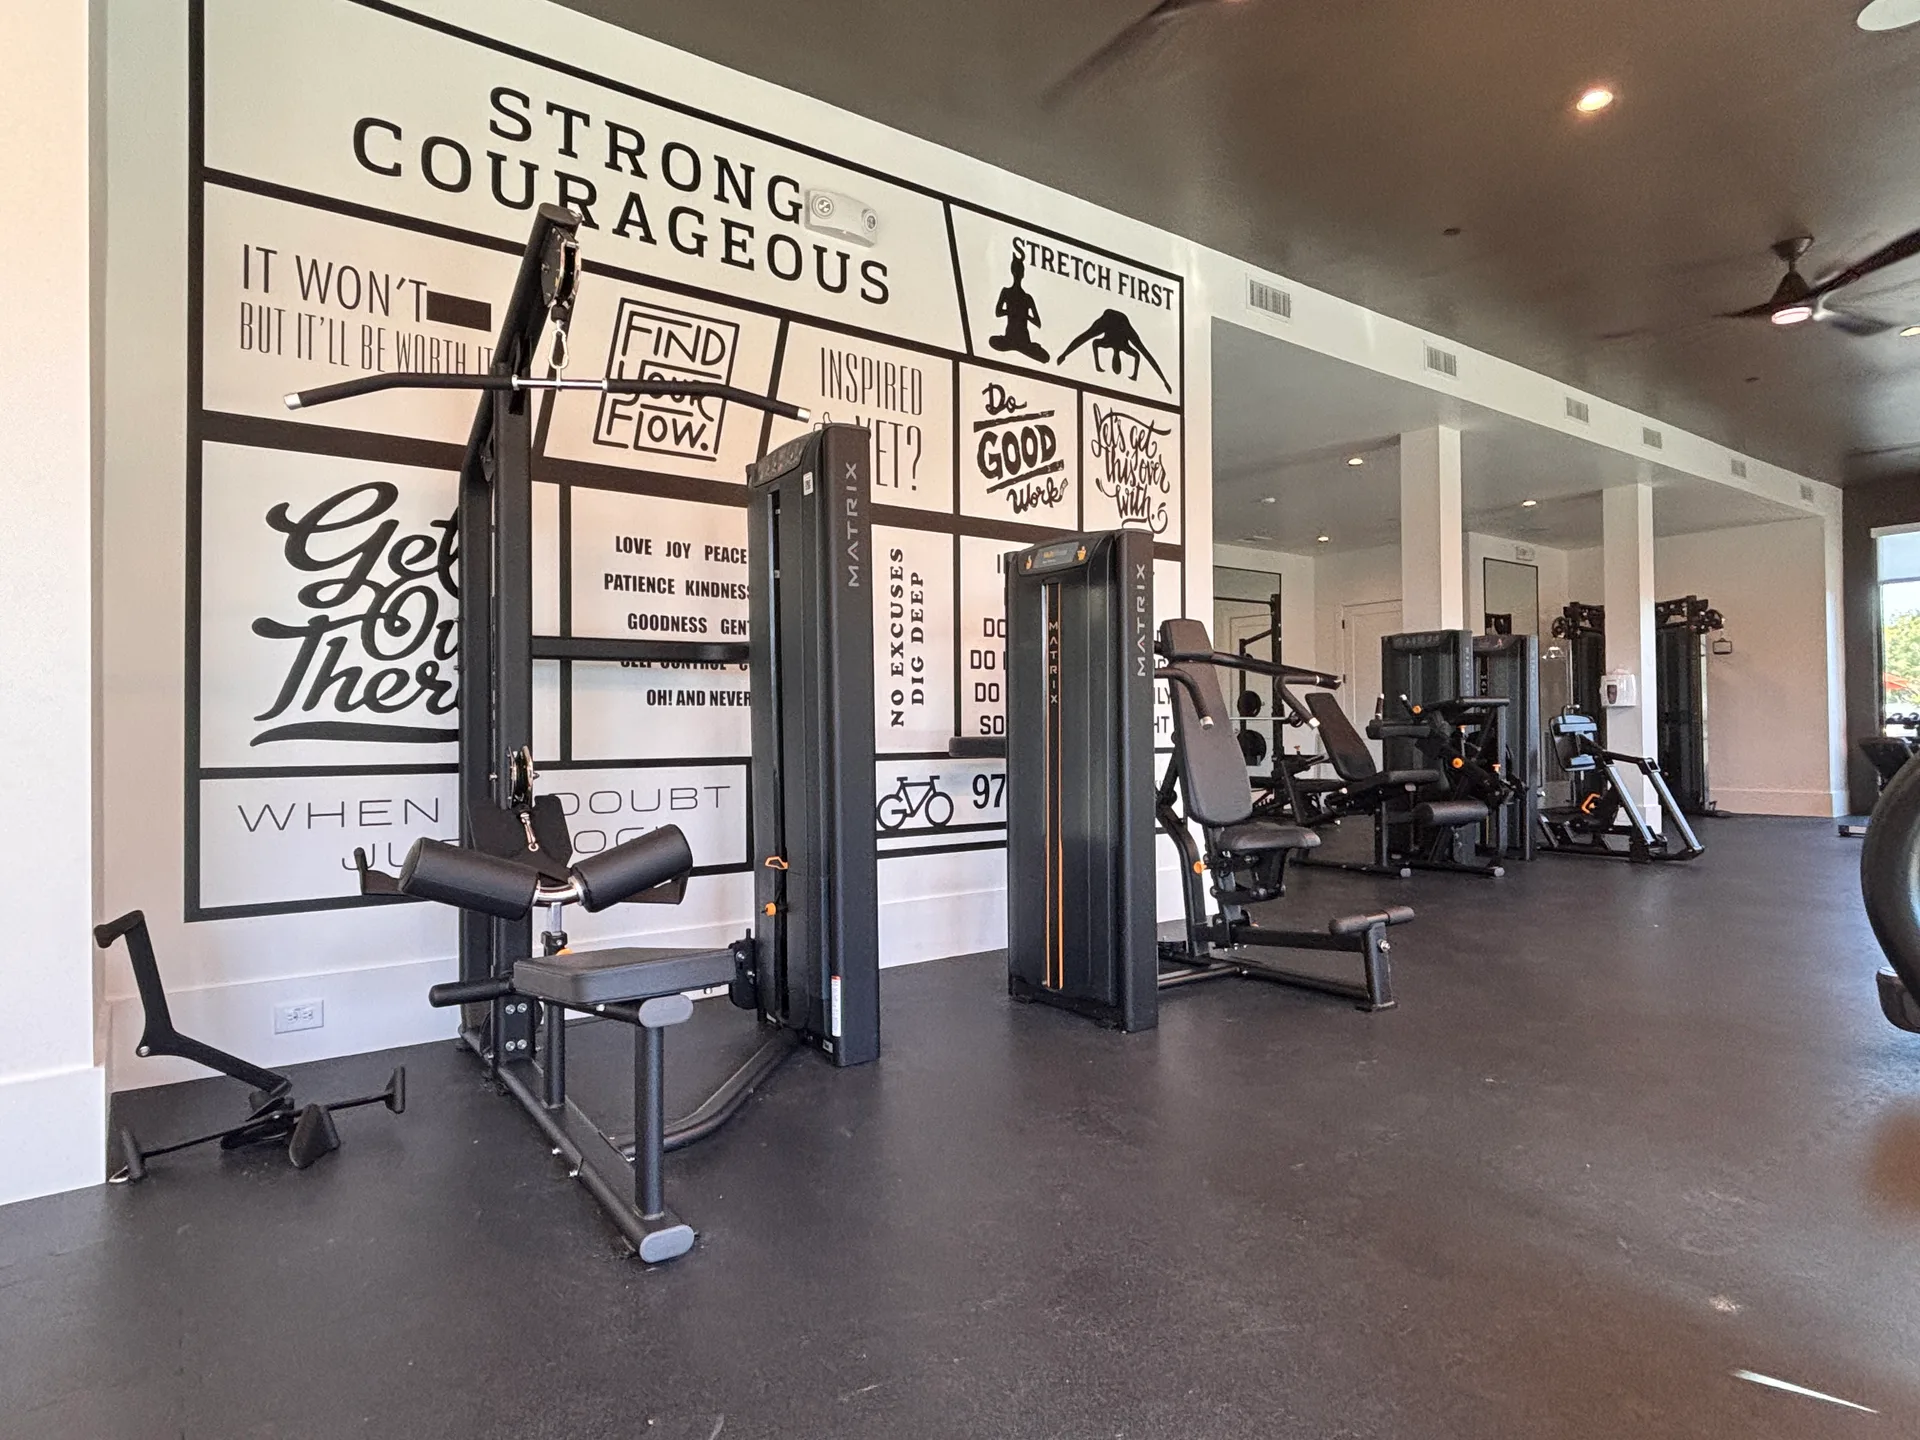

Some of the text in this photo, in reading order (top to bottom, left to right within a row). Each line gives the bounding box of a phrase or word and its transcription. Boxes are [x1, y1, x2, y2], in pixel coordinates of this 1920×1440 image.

[488, 86, 804, 224] STRONG
[353, 116, 890, 305] COURAGEOUS
[243, 243, 427, 323] IT WON'T
[1012, 236, 1174, 311] STRETCH FIRST
[240, 301, 286, 356] BUT
[361, 324, 386, 372] BE
[396, 330, 466, 375] WORTH
[621, 311, 726, 366] FIND
[821, 347, 923, 416] INSPIRED
[982, 382, 1028, 416] Do
[856, 416, 923, 491] ET?
[977, 424, 1057, 481] GOOD
[1104, 446, 1170, 494] this over
[615, 535, 748, 565] LOVE JOY PEACE
[845, 461, 860, 587] MATRIX
[604, 573, 750, 600] PATIENCE KINDNES
[1136, 563, 1146, 677] MATRIX
[627, 612, 708, 634] GOODNESS
[890, 548, 904, 727] NO EXCUSES
[911, 571, 924, 706] DIG DEEP
[970, 649, 996, 670] DO
[974, 682, 1000, 703] DO
[1048, 622, 1059, 704] MATRIX
[646, 689, 673, 706] OH!
[675, 689, 706, 706] AND
[237, 796, 440, 833] WHEN
